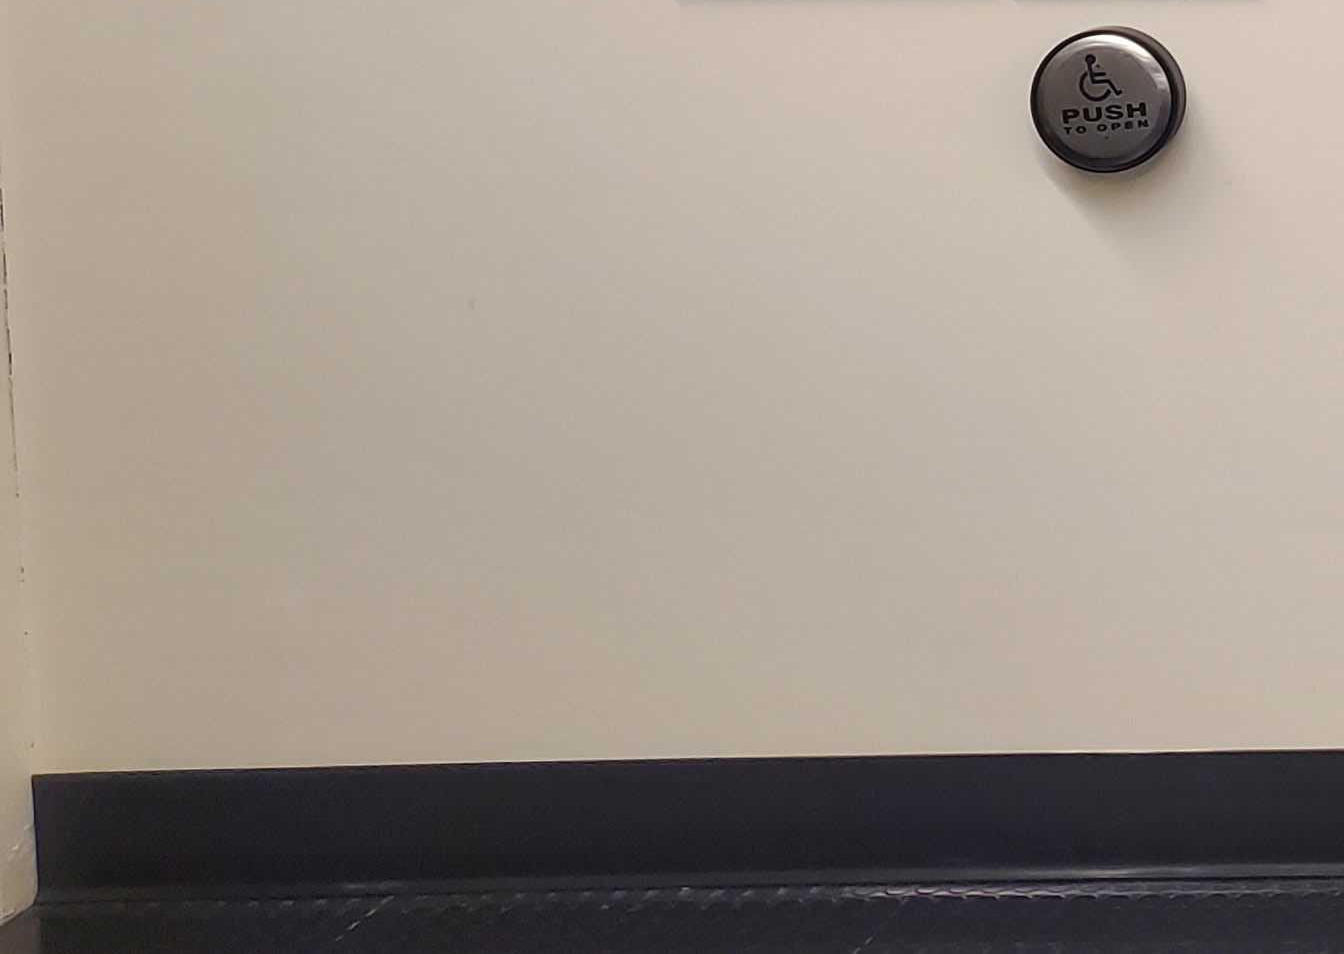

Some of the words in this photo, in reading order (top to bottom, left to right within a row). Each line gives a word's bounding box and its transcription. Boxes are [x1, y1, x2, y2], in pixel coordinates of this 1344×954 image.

[1062, 102, 1147, 124] PUSH
[1063, 125, 1087, 135] TO
[1096, 119, 1149, 133] OPEN
